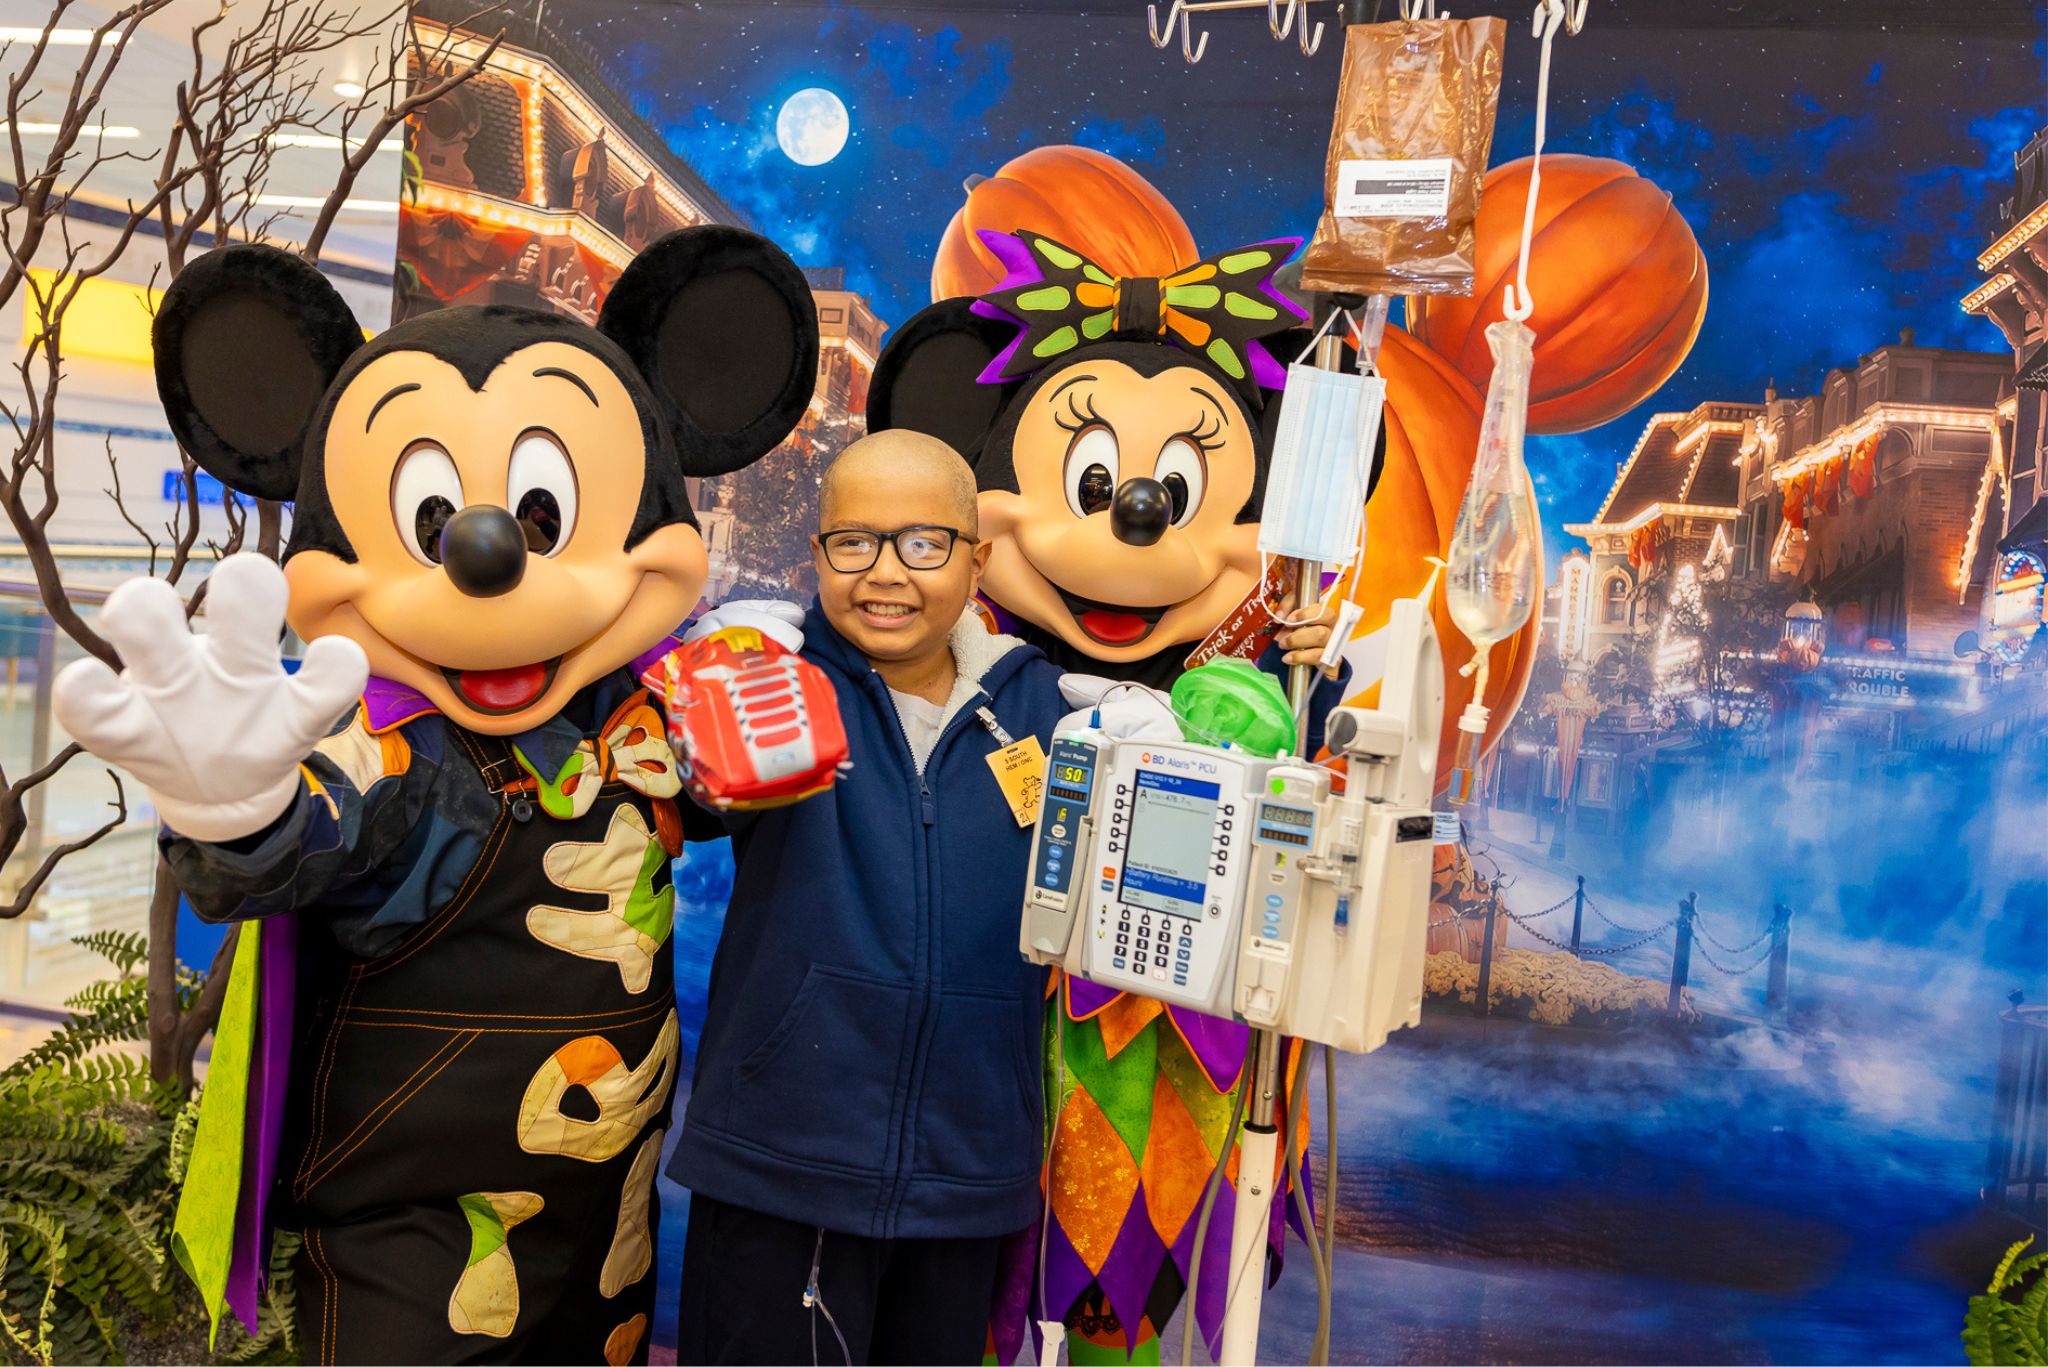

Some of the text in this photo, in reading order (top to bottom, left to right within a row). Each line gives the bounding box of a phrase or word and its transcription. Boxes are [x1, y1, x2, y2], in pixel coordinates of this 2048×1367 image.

[1568, 568, 1581, 620] MARKET
[1231, 615, 1243, 632] or
[1846, 680, 1909, 698] ROUBLE
[1009, 751, 1028, 763] SOUTH
[1152, 754, 1165, 765] BD
[1198, 762, 1217, 774] PCU
[1005, 762, 1018, 772] HEM
[1065, 767, 1083, 782] 50
[1140, 789, 1147, 799] A
[1152, 873, 1178, 886] Runtime
